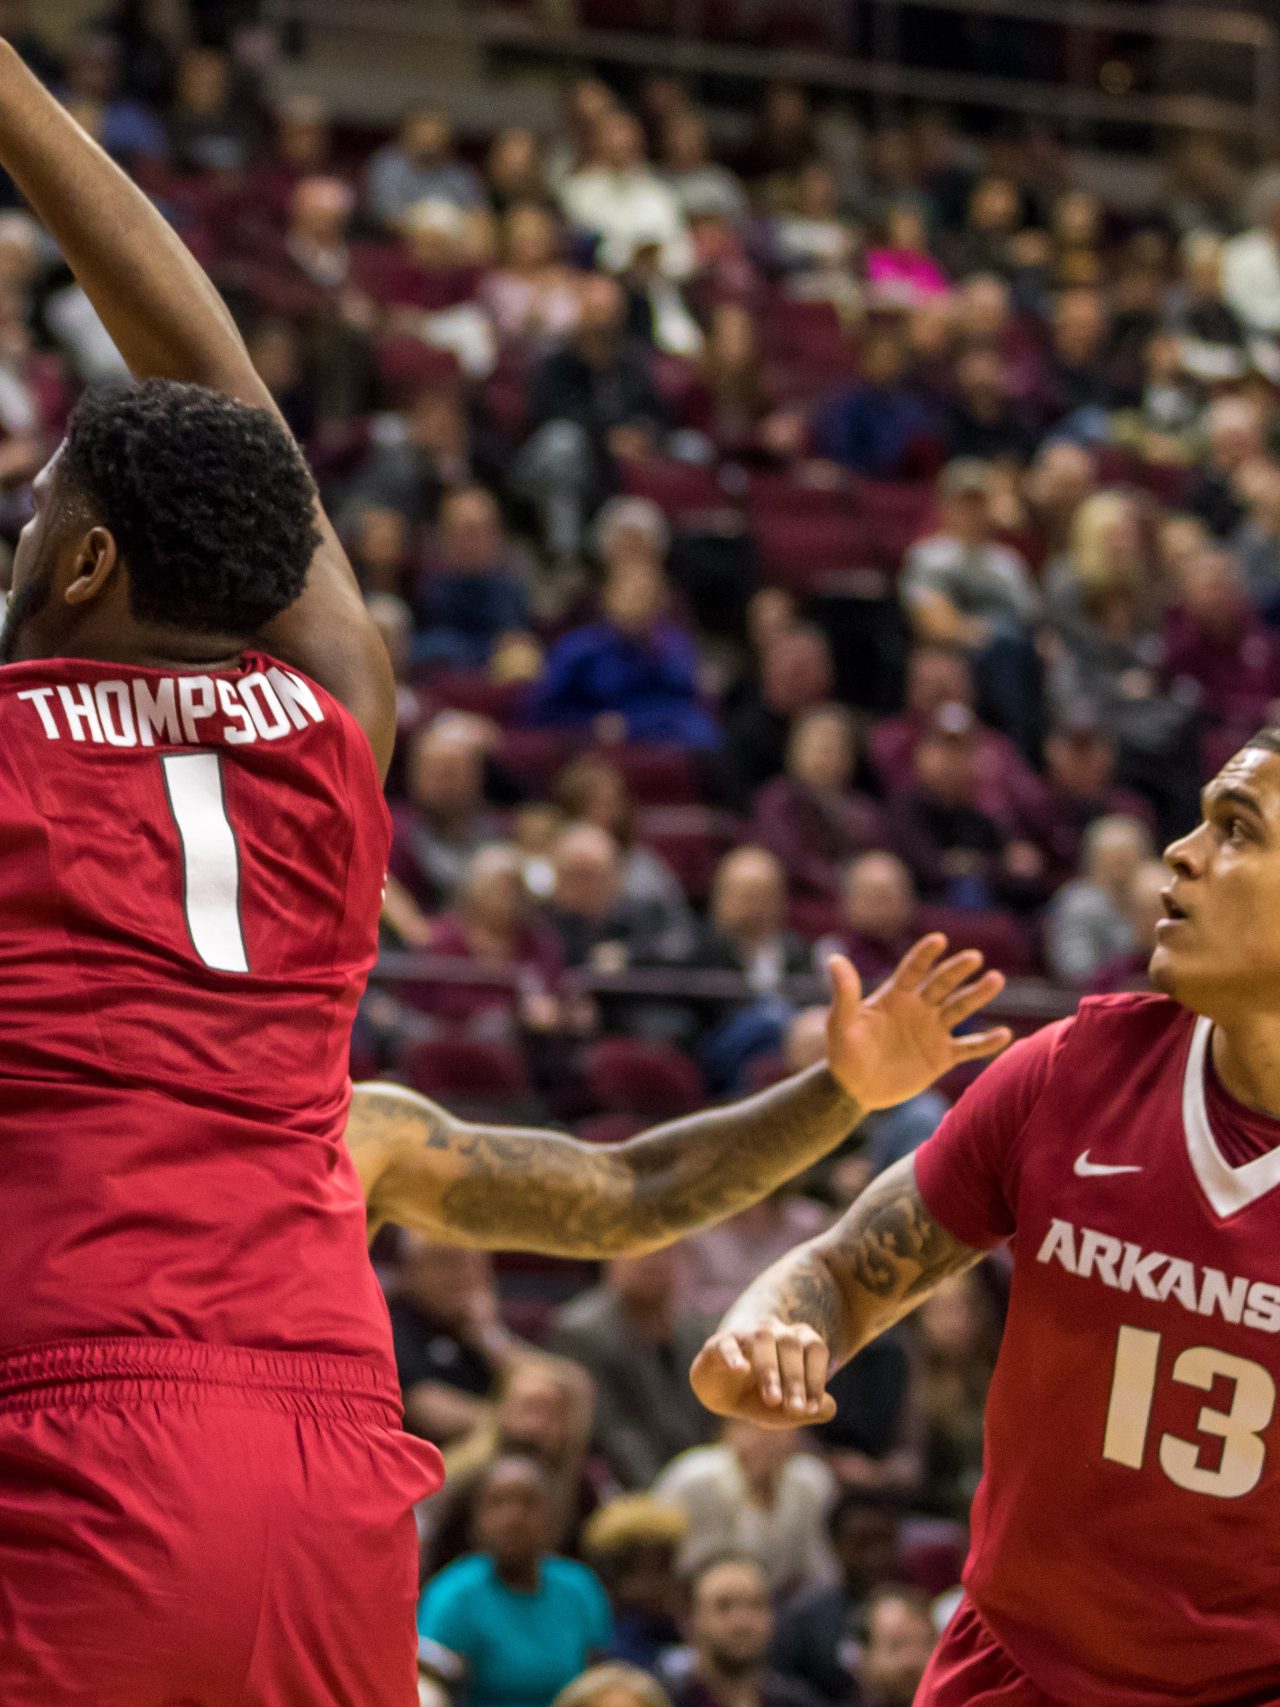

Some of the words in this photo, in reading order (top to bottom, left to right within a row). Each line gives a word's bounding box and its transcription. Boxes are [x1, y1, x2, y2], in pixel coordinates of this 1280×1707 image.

[17, 666, 325, 747] THOMPSON
[160, 752, 251, 973] 1
[1036, 1217, 1280, 1334] ARKANS
[1103, 1324, 1276, 1499] 13
